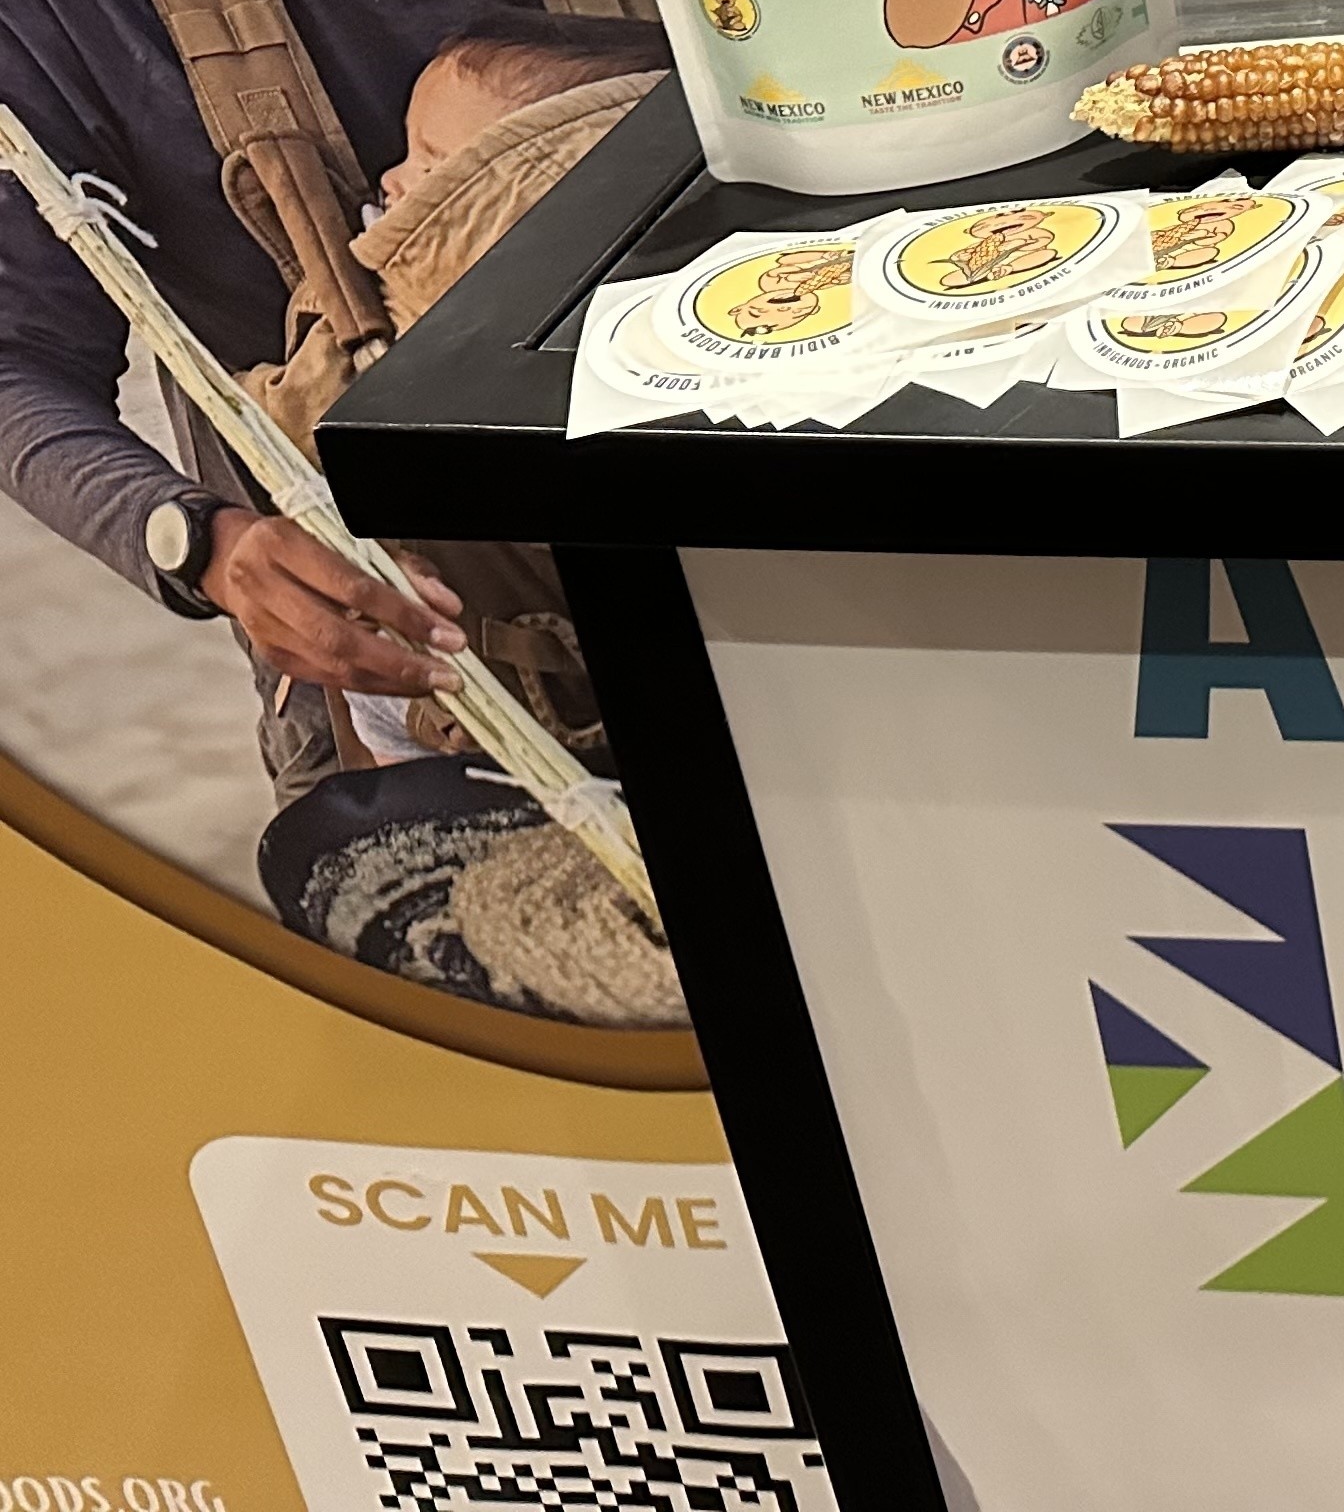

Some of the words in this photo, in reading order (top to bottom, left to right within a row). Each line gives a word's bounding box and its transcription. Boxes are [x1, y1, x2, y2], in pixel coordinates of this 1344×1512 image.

[862, 92, 896, 108] NEW
[902, 81, 963, 103] MEXICO
[767, 102, 825, 117] MEXICO
[1018, 267, 1071, 296] ORGANIC
[1163, 348, 1218, 369] ORGANIC
[307, 1173, 570, 1241] SCAN
[590, 1193, 727, 1251] ME
